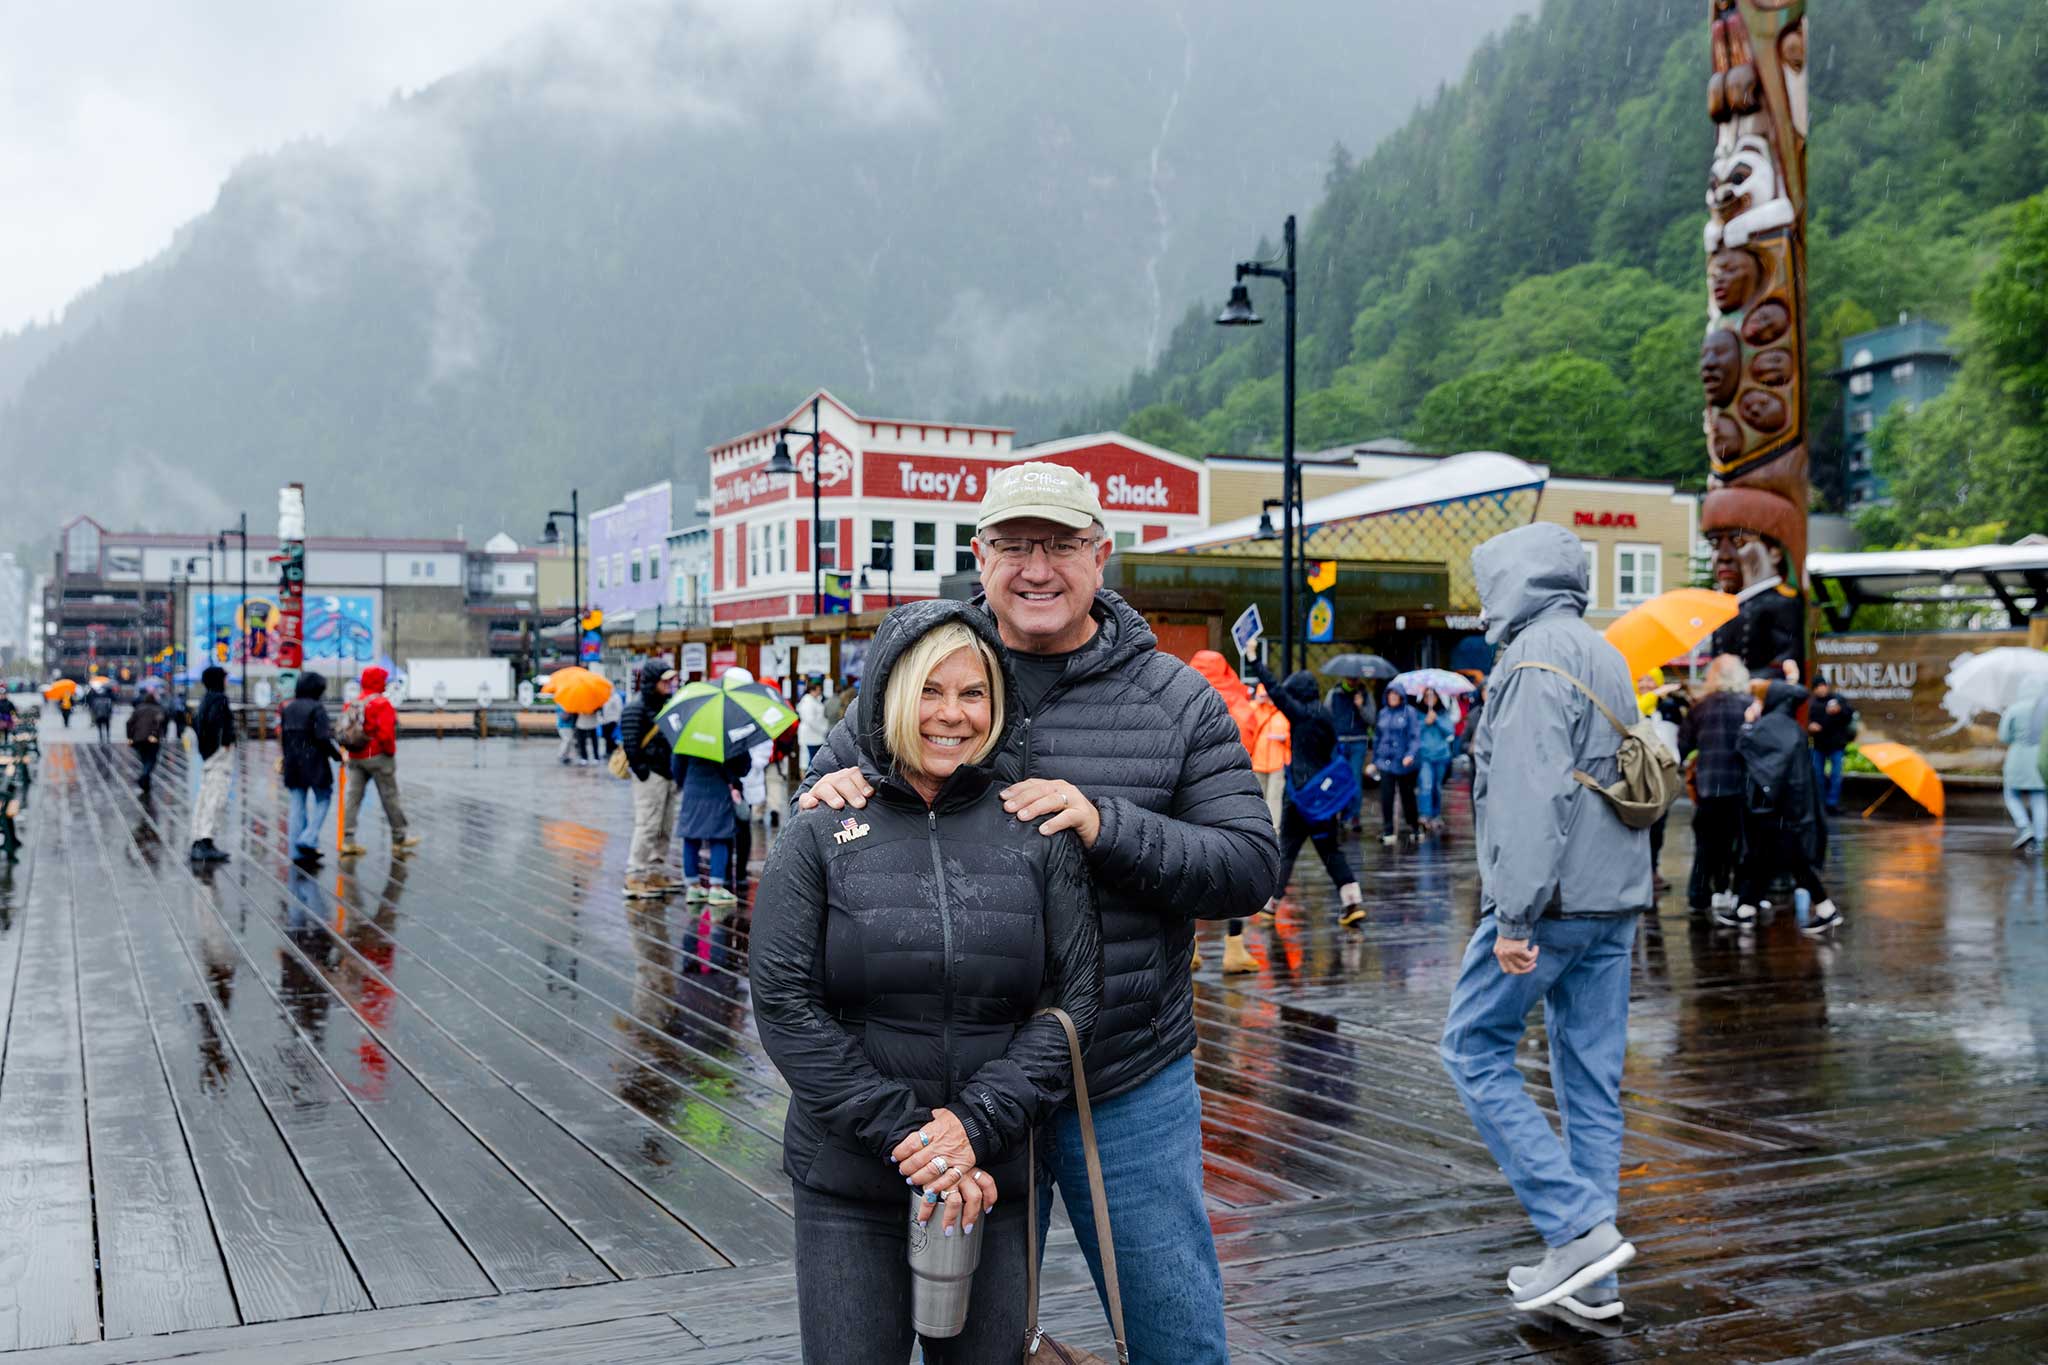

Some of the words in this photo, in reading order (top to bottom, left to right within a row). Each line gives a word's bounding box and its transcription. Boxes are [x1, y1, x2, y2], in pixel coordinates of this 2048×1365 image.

[899, 461, 978, 500] Tracy's
[1106, 474, 1169, 507] Shack
[1023, 472, 1068, 486] Office
[833, 823, 870, 845] TRUMP
